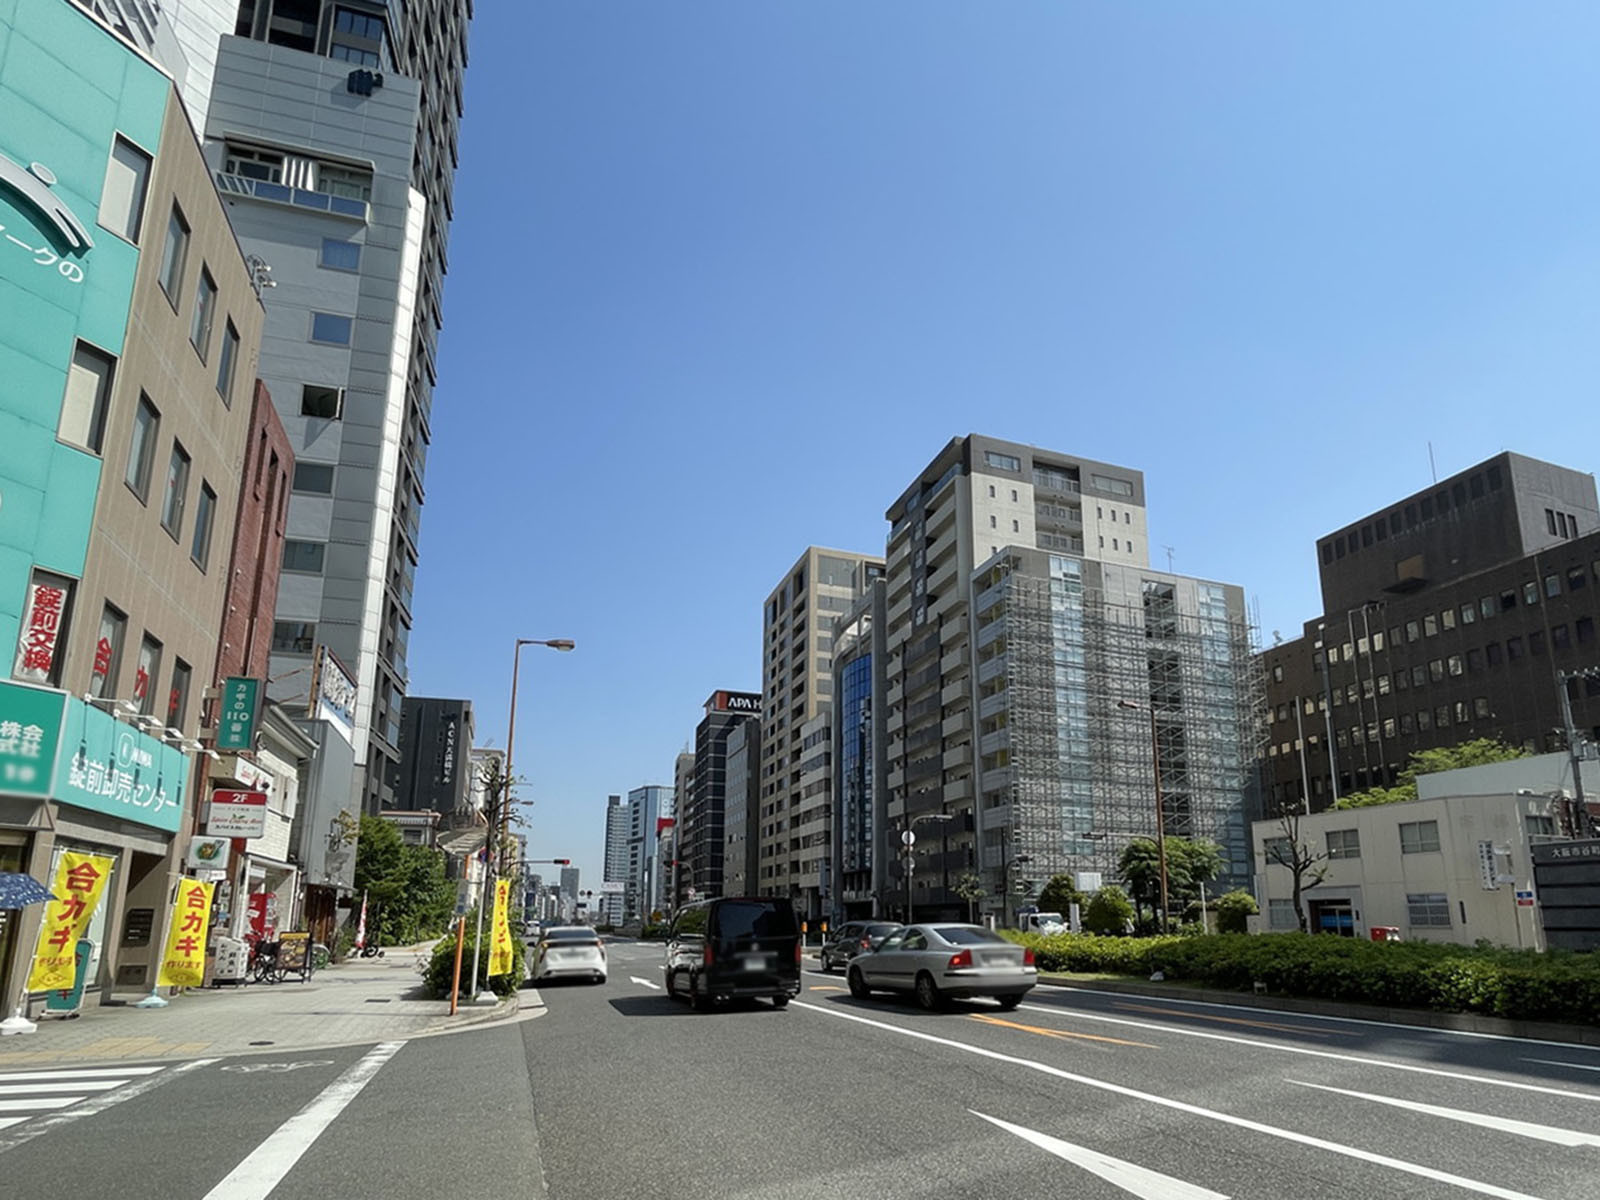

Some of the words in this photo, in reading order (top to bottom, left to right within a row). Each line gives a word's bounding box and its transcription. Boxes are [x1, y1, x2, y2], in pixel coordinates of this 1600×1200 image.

[0, 224, 84, 283] ークの
[728, 697, 752, 709] APA
[68, 751, 178, 812] 錠前卸売センター
[232, 792, 249, 803] 2F
[48, 862, 101, 954] 合カギ
[175, 885, 207, 958] 合カギ
